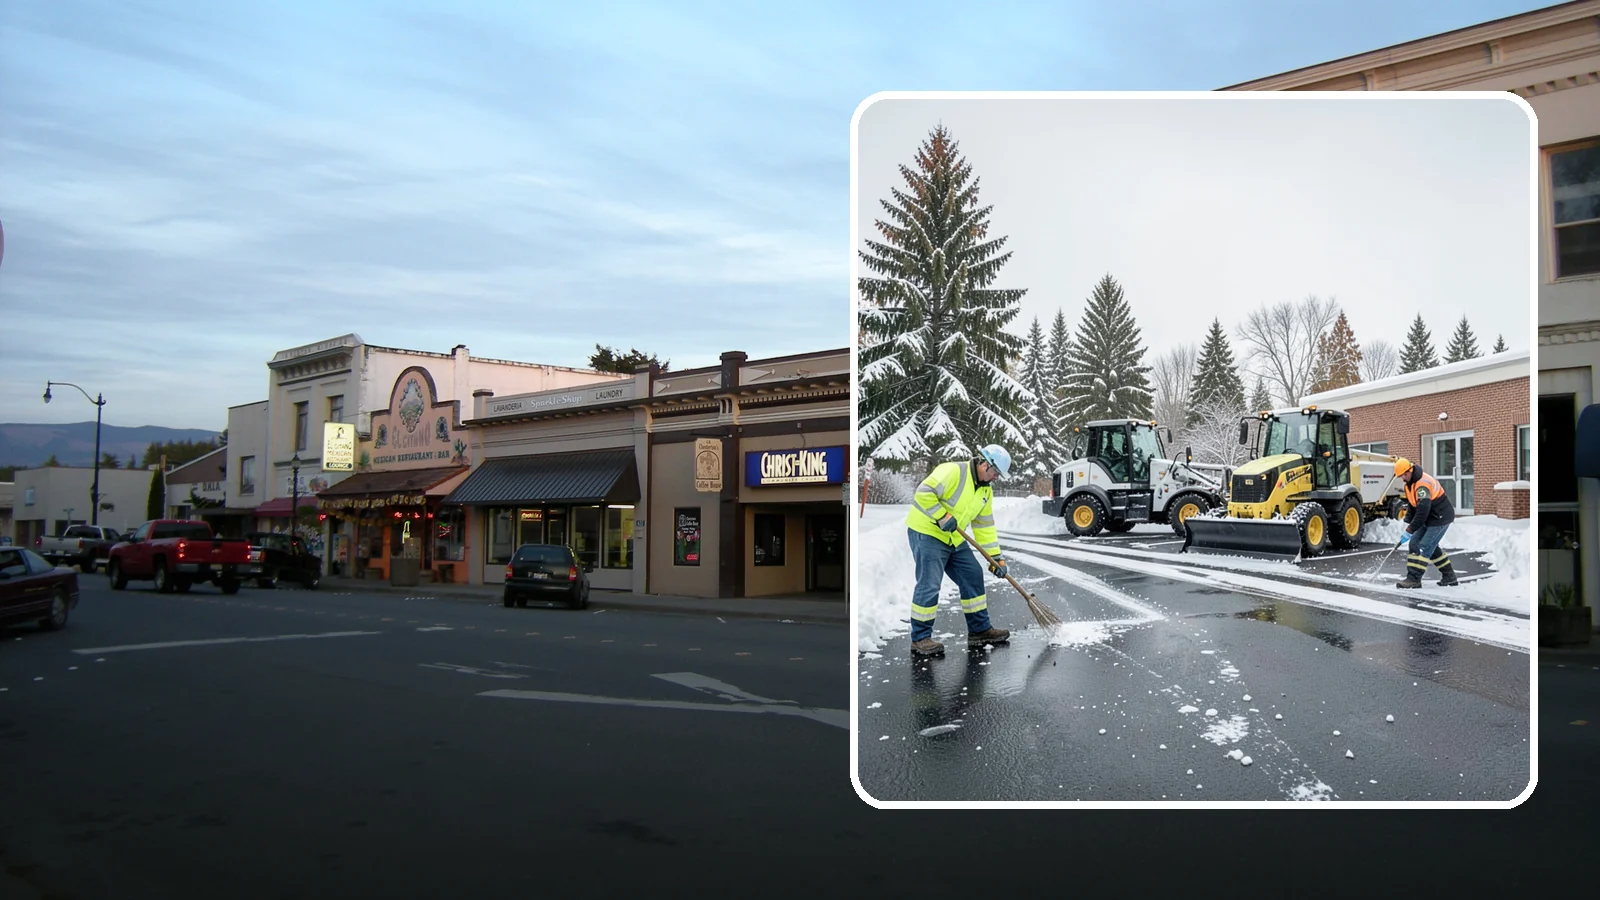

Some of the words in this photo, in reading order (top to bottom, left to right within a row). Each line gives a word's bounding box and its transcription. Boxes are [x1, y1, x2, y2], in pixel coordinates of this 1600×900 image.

[595, 388, 624, 400] LAUNDRY
[493, 402, 522, 412] LAVANDERIA
[530, 396, 560, 409] Sparkle
[561, 394, 583, 405] Shop
[373, 455, 396, 464] MEXICAN
[397, 451, 434, 462] RESTAURANT
[438, 450, 450, 459] BAR
[760, 452, 797, 478] CHRIST
[799, 450, 828, 476] KING
